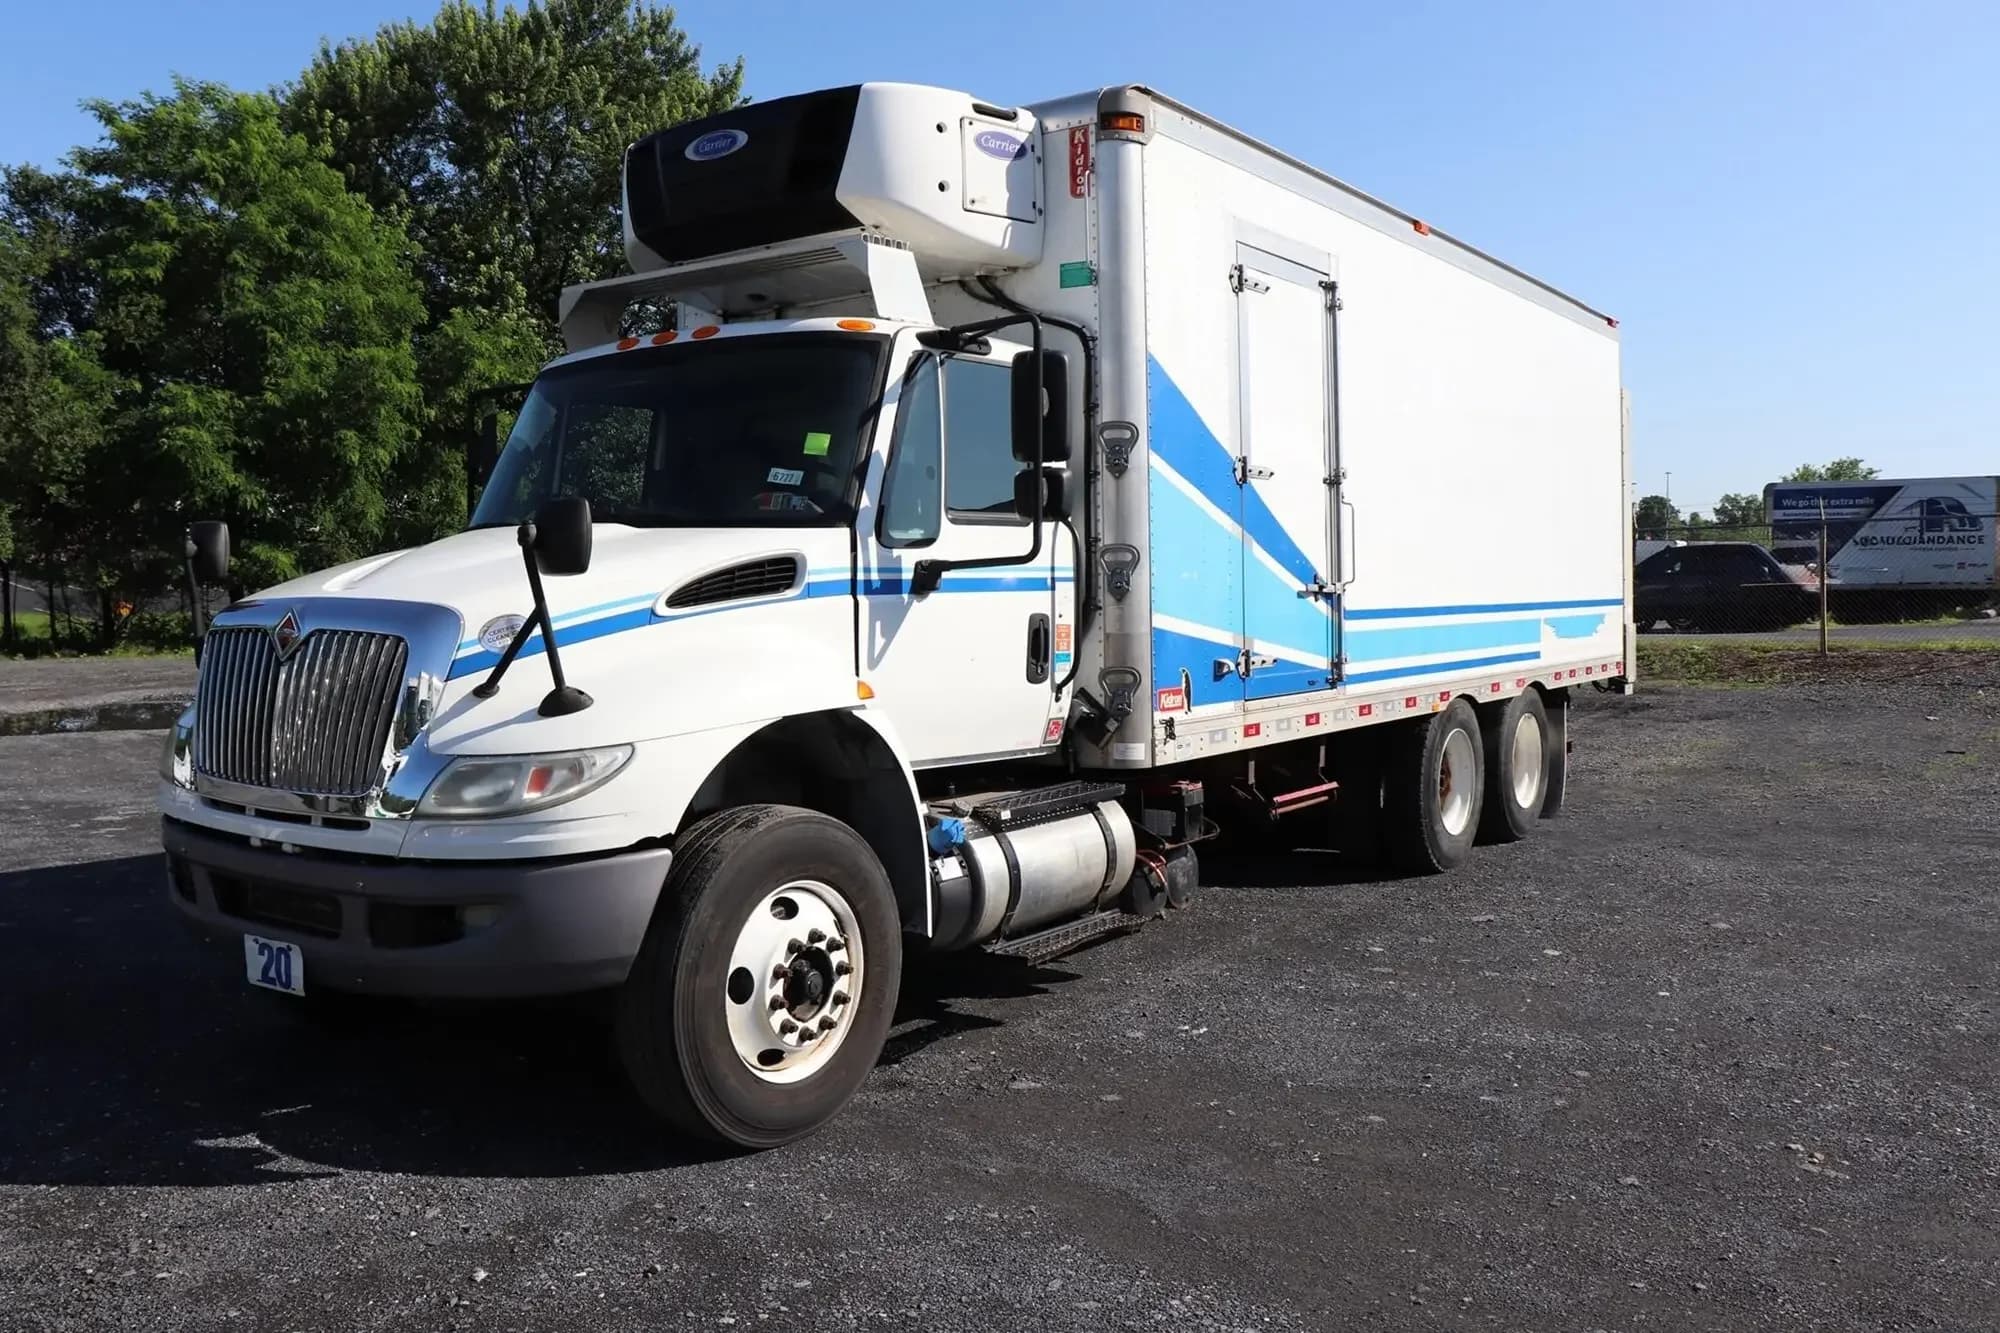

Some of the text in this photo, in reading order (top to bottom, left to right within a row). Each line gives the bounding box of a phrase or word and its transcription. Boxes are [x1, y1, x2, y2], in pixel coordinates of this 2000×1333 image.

[981, 134, 1020, 153] Carrier
[1073, 128, 1085, 195] Kidron
[1810, 498, 1829, 506] tht
[258, 942, 292, 990] 20
